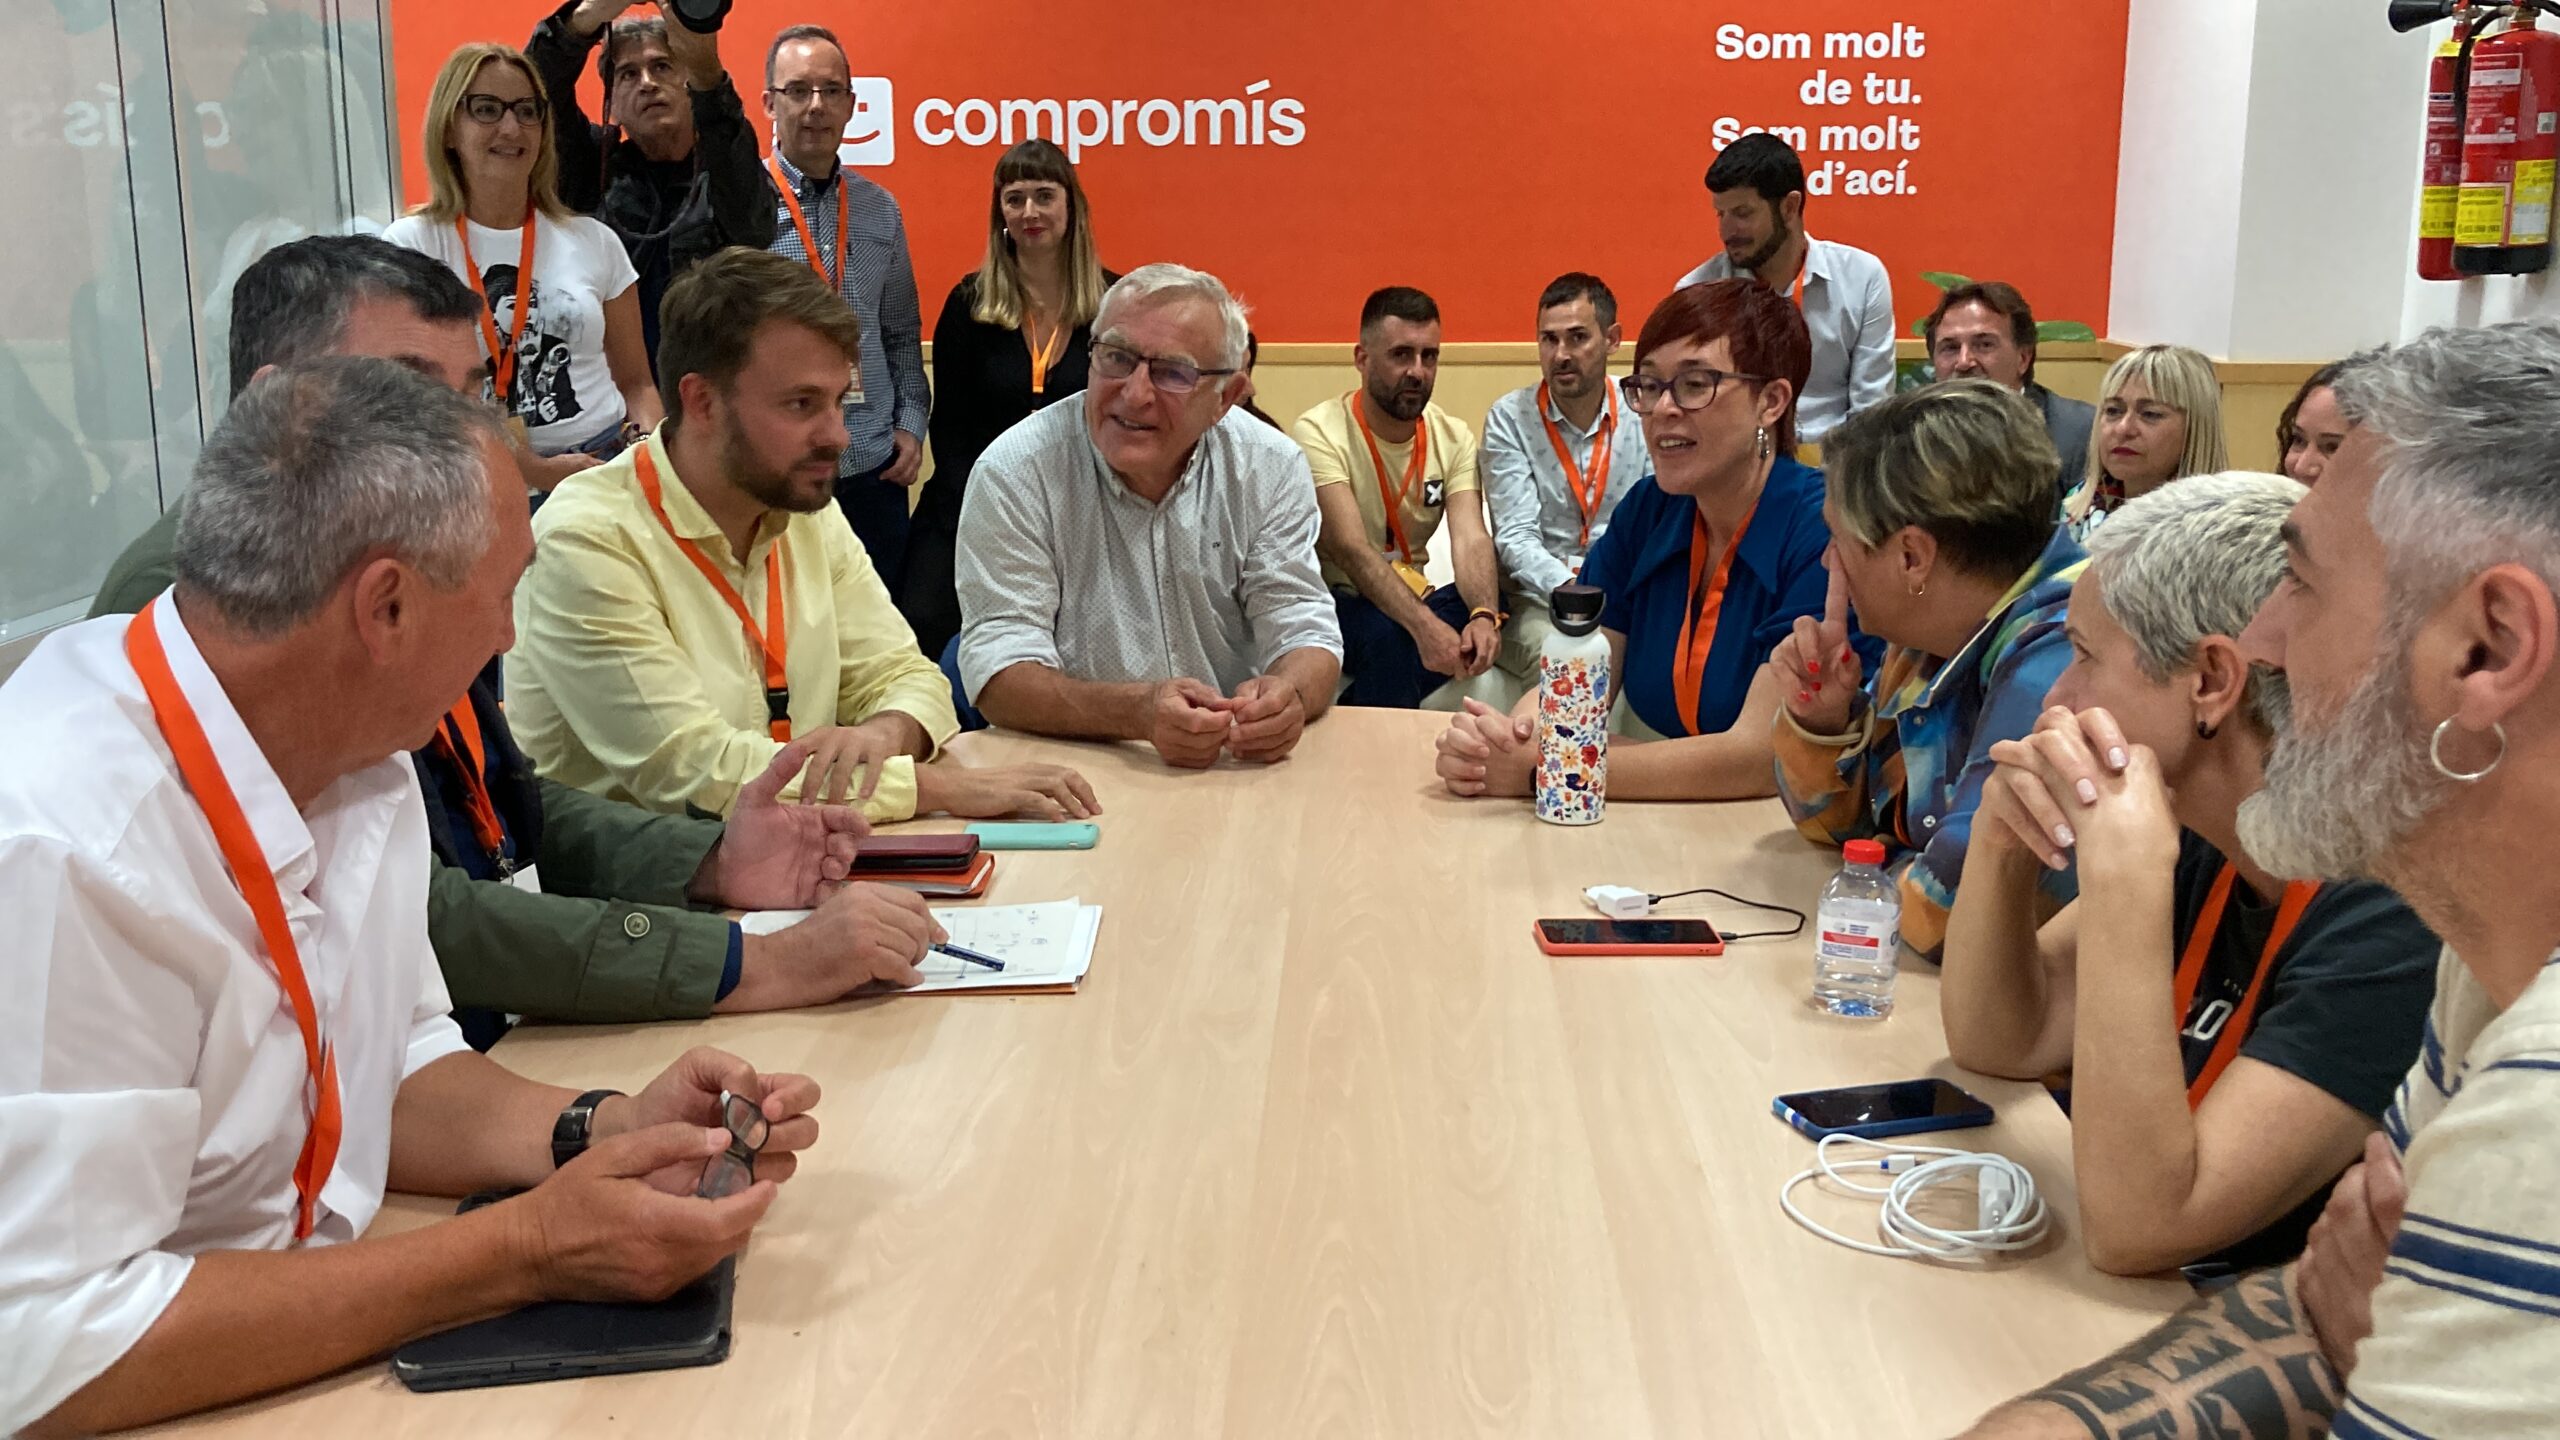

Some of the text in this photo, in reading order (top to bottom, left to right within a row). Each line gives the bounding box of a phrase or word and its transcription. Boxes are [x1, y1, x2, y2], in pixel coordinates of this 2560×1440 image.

[1715, 22, 1926, 60] Som molt
[1799, 69, 1922, 105] de tu.
[913, 79, 1306, 165] compromís
[1711, 115, 1921, 152] Sm molt
[1806, 159, 1918, 196] d’ací.
